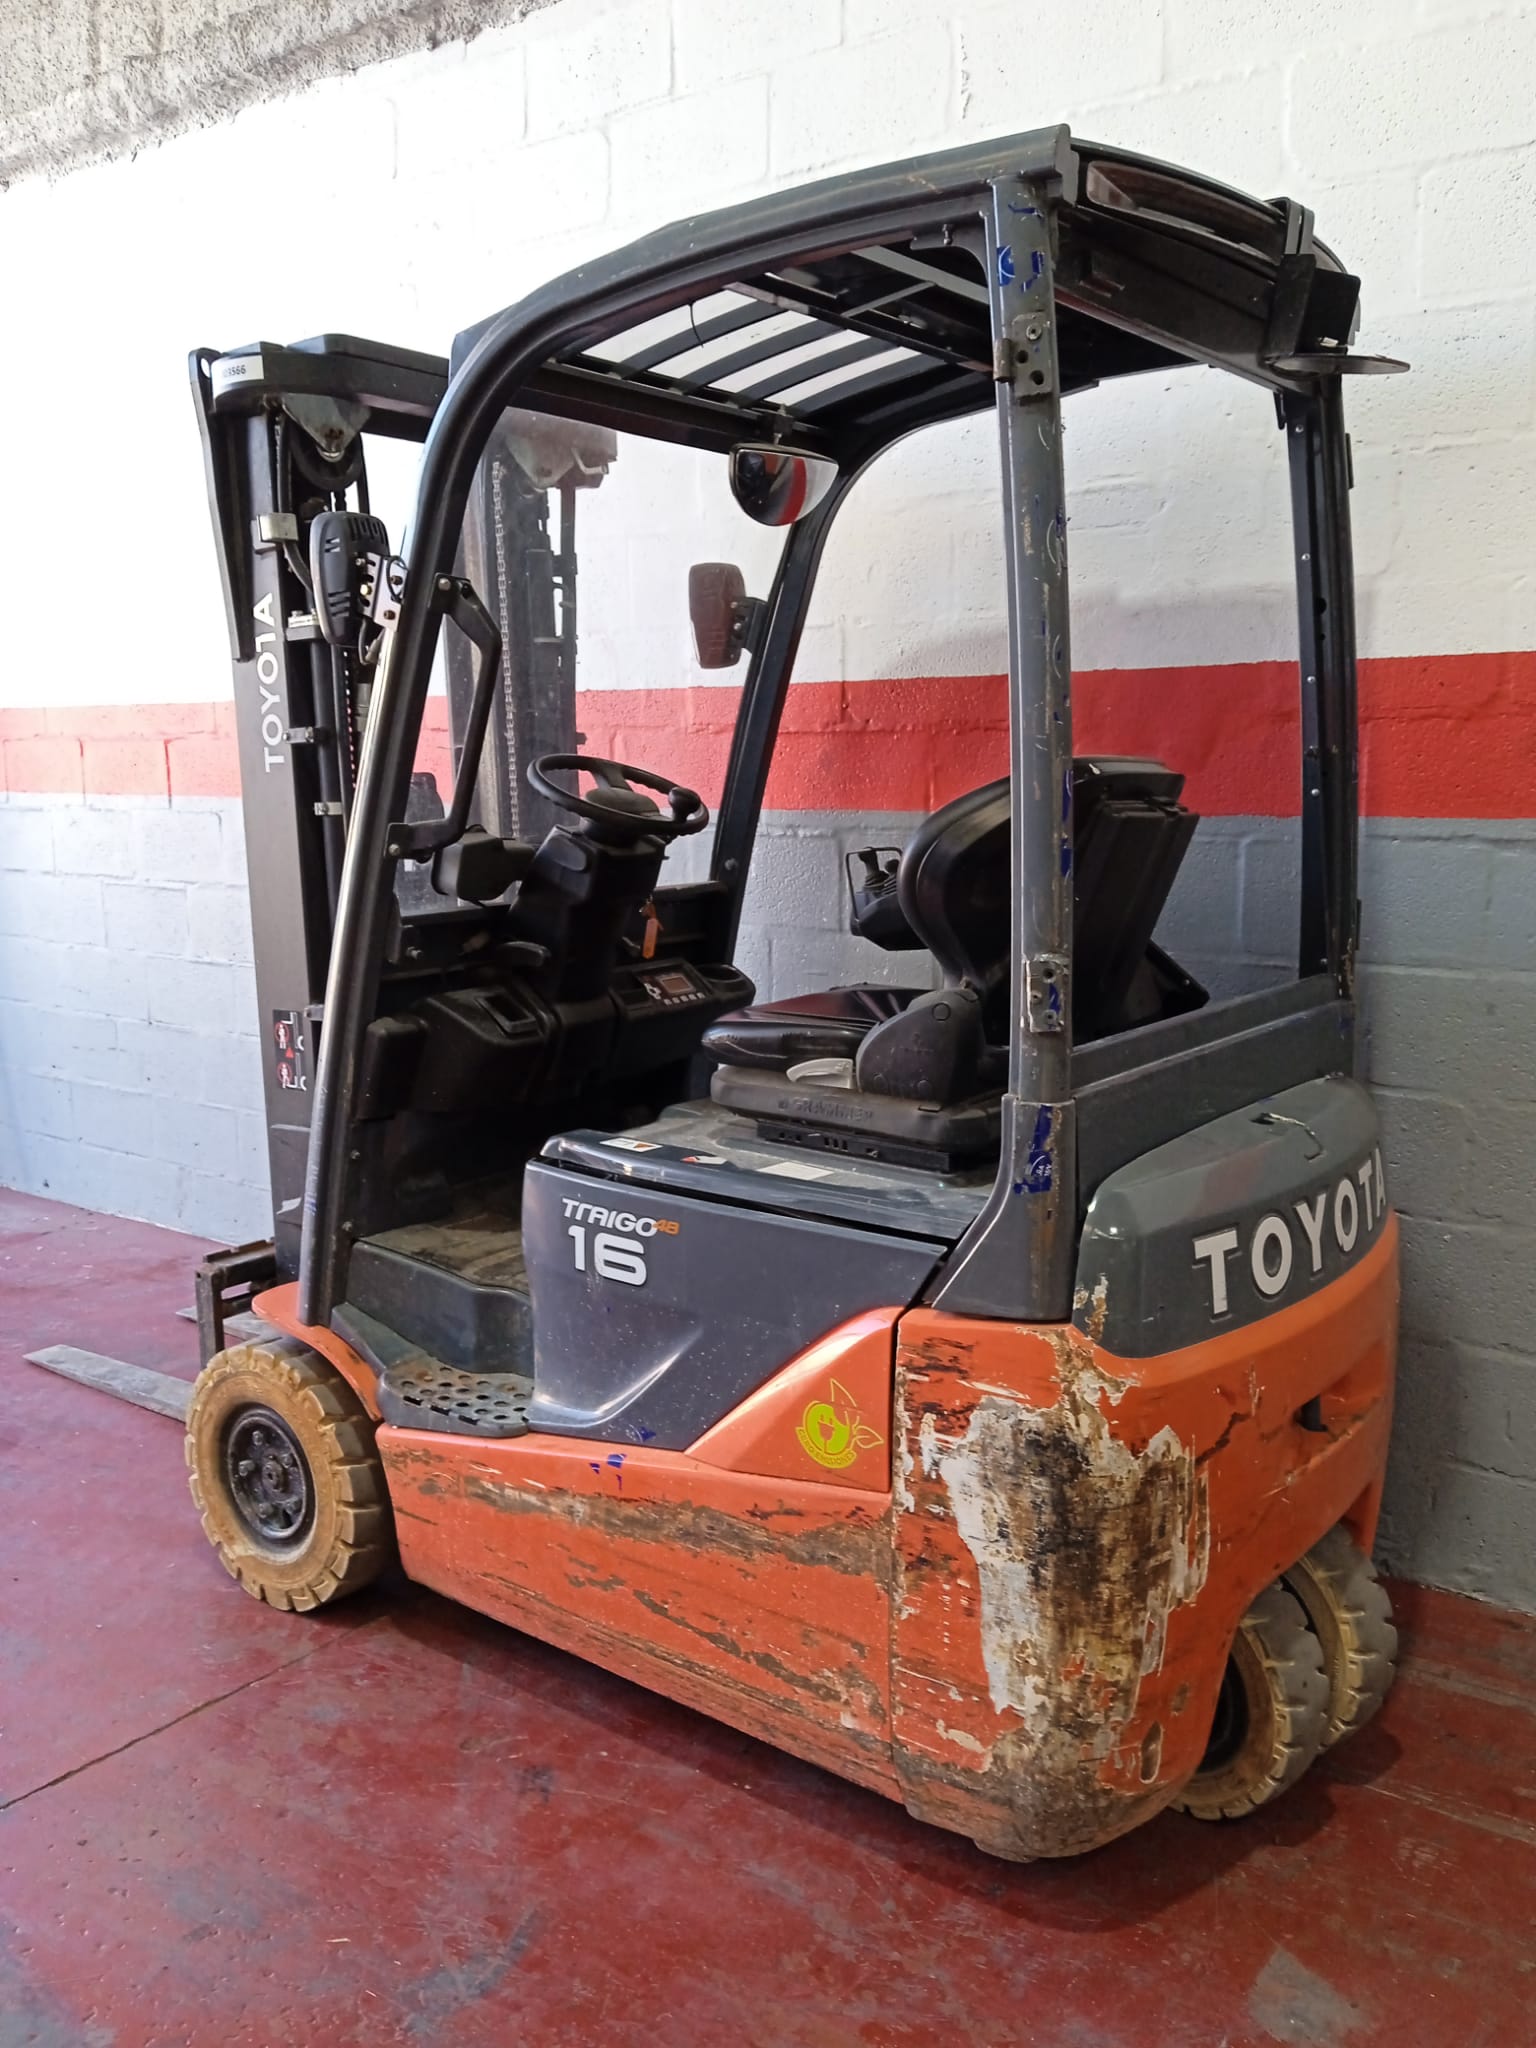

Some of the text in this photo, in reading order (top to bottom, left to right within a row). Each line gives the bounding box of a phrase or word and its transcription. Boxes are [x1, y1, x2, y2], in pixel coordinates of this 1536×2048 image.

[252, 592, 286, 773] TOYOTA
[568, 1225, 647, 1286] 16
[1193, 1147, 1386, 1314] TOYOTA
